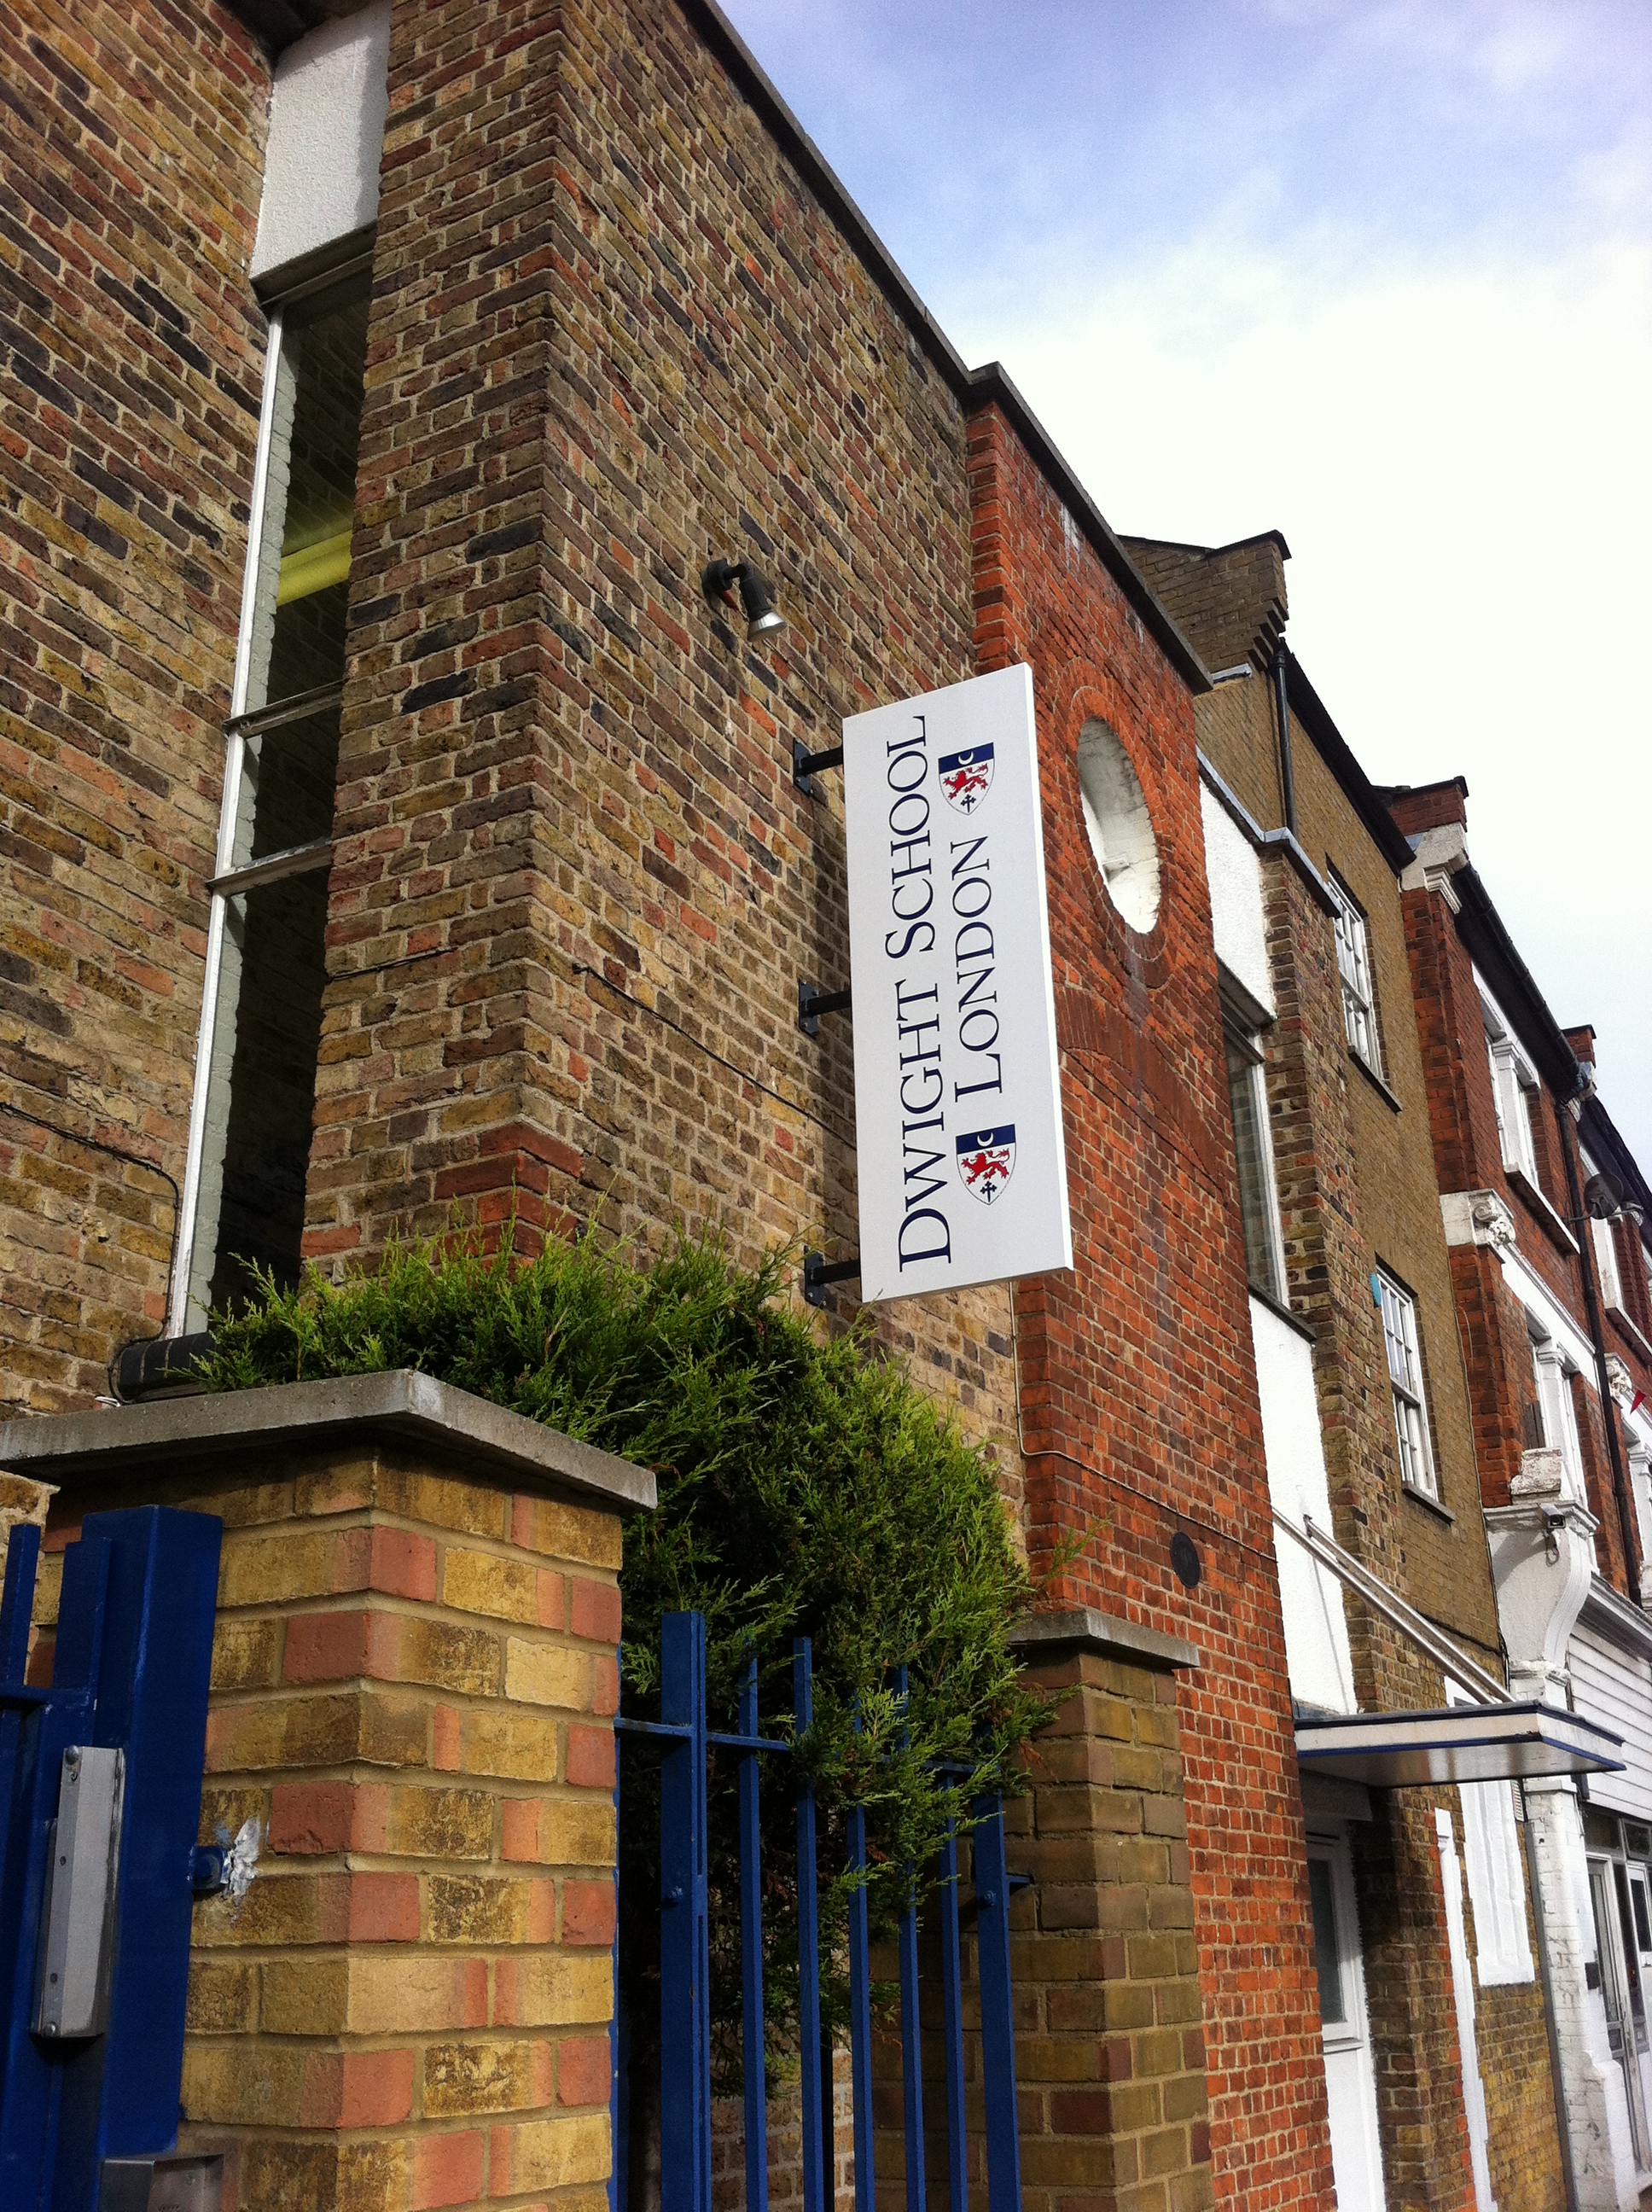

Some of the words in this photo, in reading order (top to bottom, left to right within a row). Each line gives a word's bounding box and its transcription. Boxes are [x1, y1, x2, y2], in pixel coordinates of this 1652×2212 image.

[886, 715, 935, 959] SCHOOL
[950, 835, 1003, 1103] LONDON
[895, 978, 951, 1272] DWIGHT
